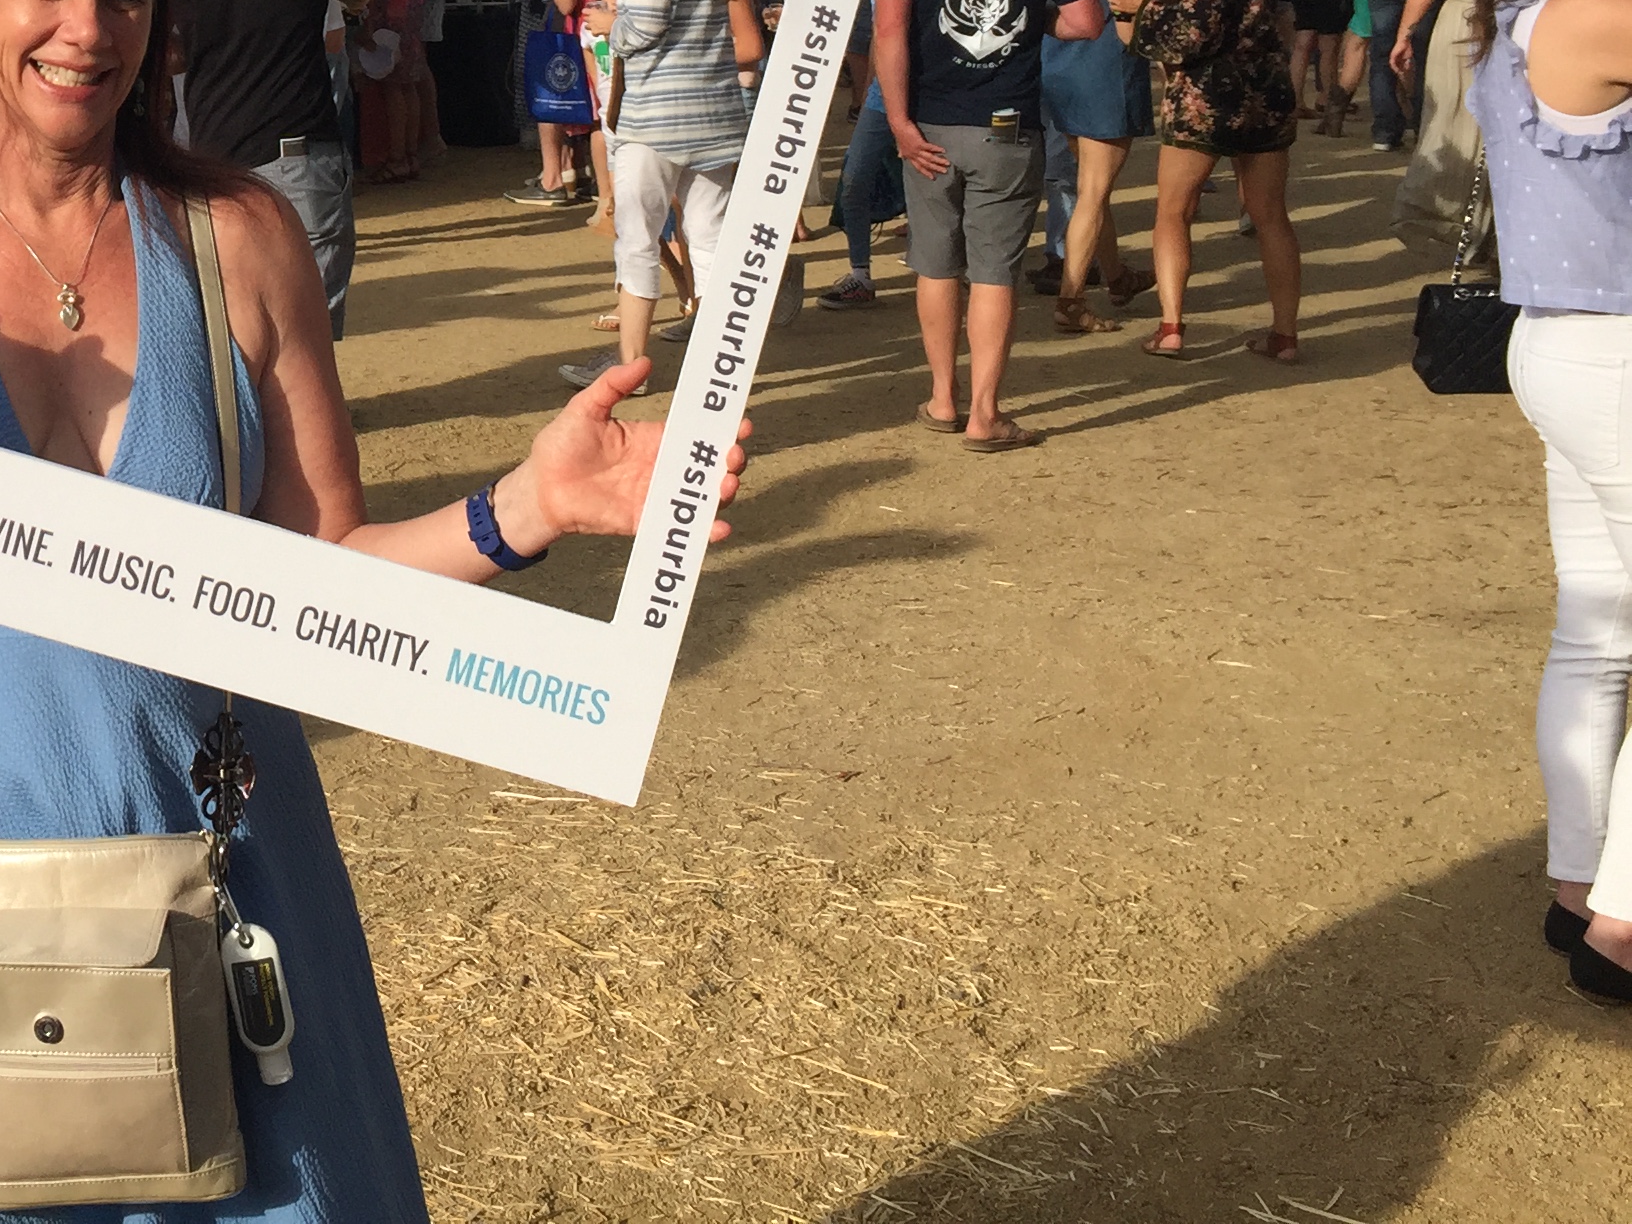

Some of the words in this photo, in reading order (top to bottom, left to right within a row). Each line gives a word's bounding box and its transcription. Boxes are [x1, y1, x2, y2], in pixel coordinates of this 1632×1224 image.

[764, 6, 840, 194] #sipurbia
[704, 224, 778, 411] #sipurbia
[644, 441, 718, 628] #sipurbia
[70, 541, 174, 602] MUSIC.
[193, 576, 276, 631] FOOD.
[296, 607, 429, 675] CHARITY.
[446, 649, 609, 724] MEMORIES
